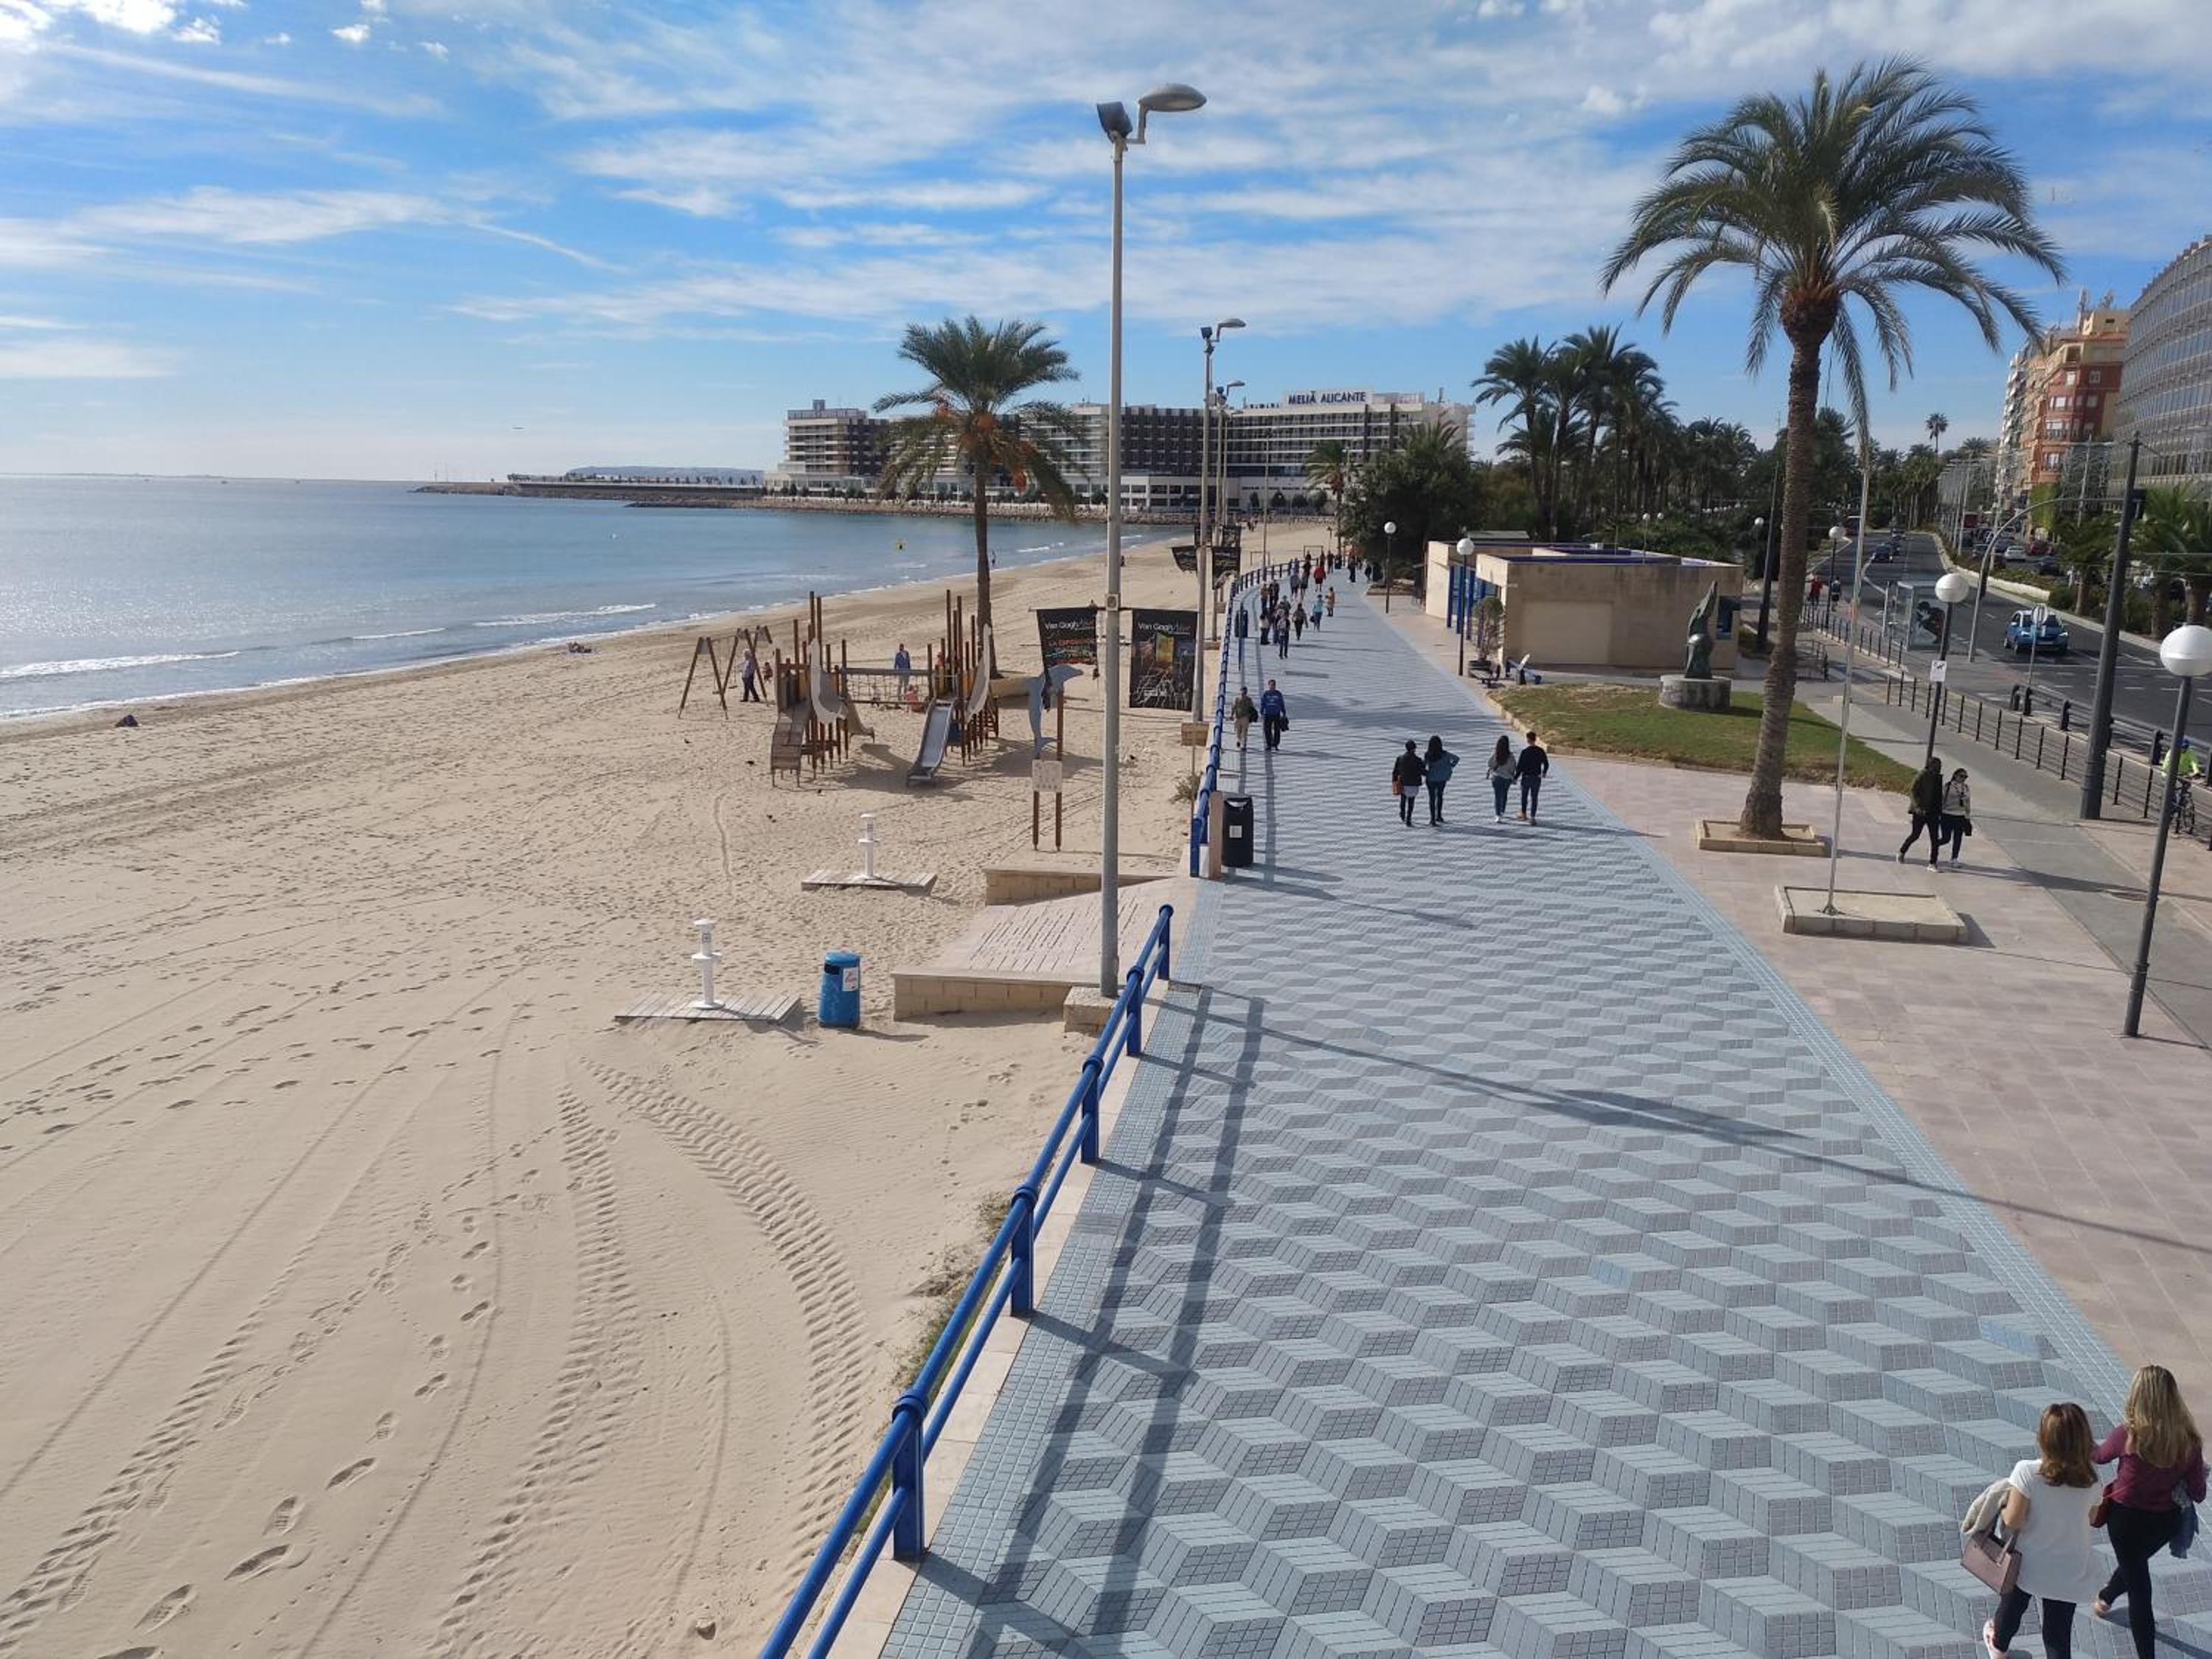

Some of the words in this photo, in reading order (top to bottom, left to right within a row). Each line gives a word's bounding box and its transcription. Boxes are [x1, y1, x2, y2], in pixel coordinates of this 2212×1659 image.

[1288, 391, 1316, 405] MELIÁ
[1321, 392, 1366, 403] ALICANTE
[1138, 622, 1152, 630] Van
